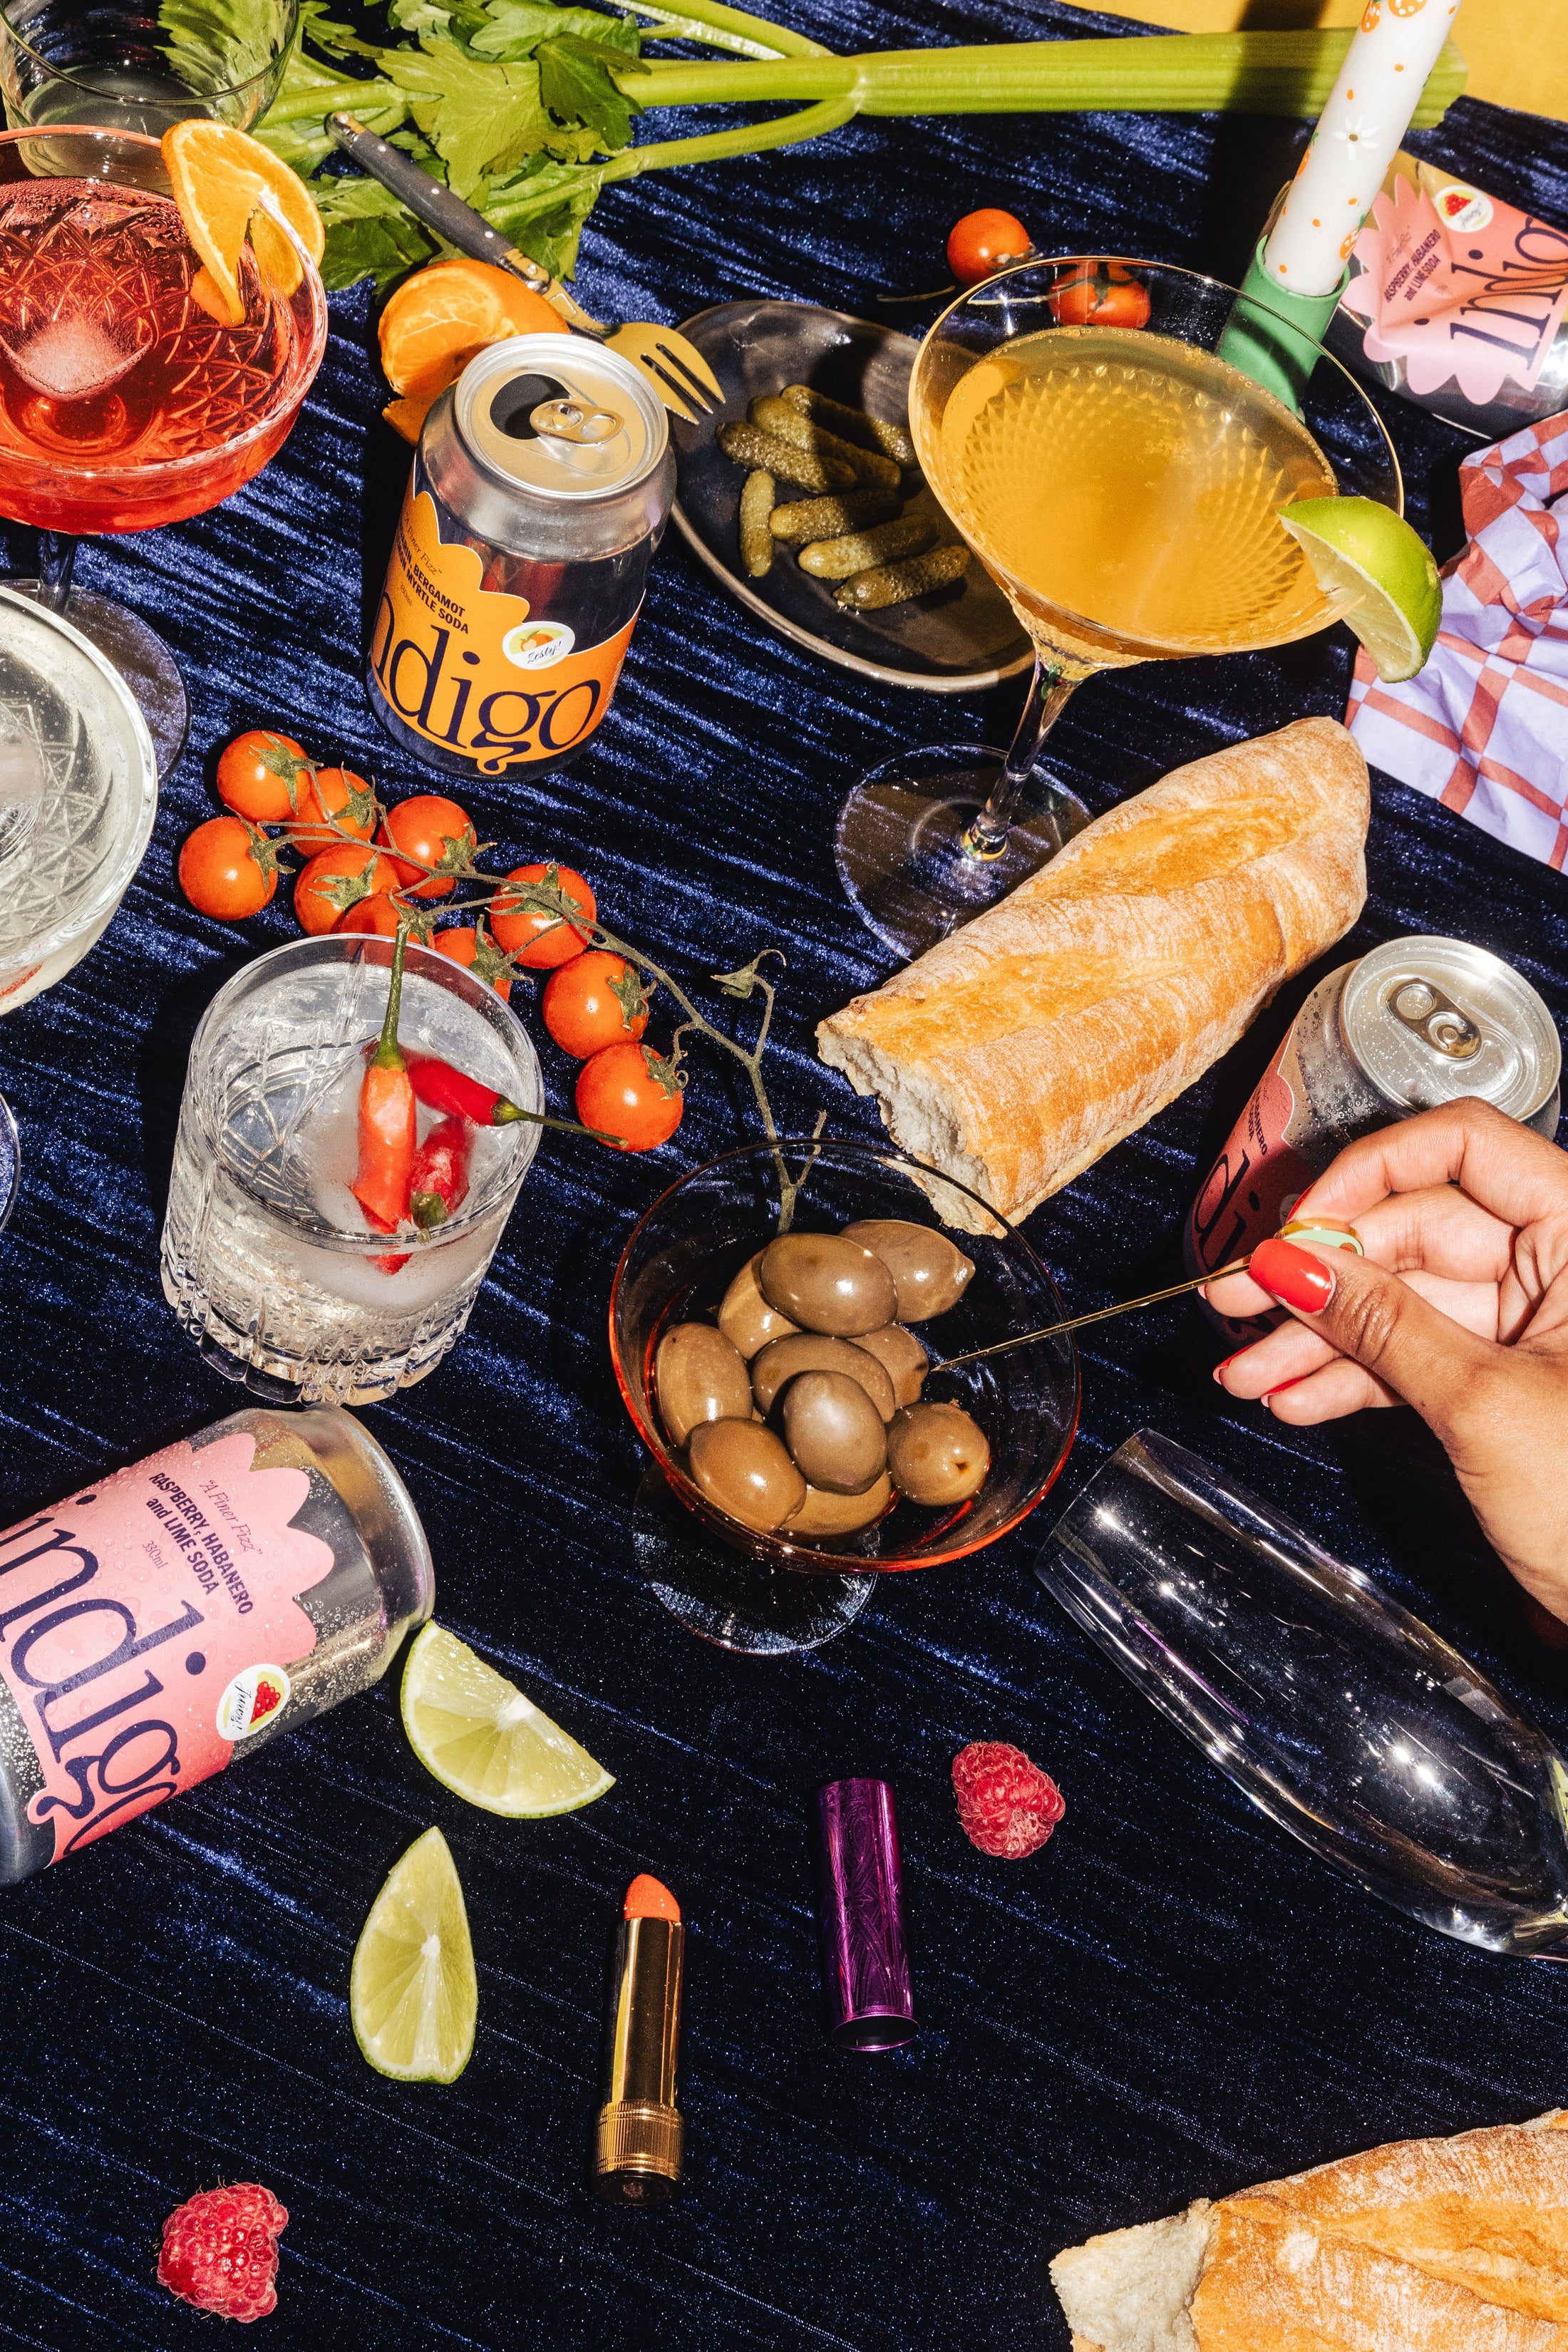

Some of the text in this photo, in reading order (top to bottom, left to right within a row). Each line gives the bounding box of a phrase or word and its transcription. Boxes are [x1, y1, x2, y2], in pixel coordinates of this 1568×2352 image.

[1410, 229, 1441, 267] HABANERO
[1421, 254, 1441, 275] SODA
[406, 568, 438, 613] MYRTLE
[438, 608, 469, 634] SODA
[413, 563, 465, 618] BERGAMOT
[527, 640, 562, 664] Zesty!
[208, 1491, 239, 1522] Finer
[143, 1540, 168, 1569] 330ml
[145, 1497, 220, 1595] and LIME SODA
[148, 1472, 254, 1615] RASPBERRY, HABANERO
[230, 1681, 252, 1731] Juicy!
